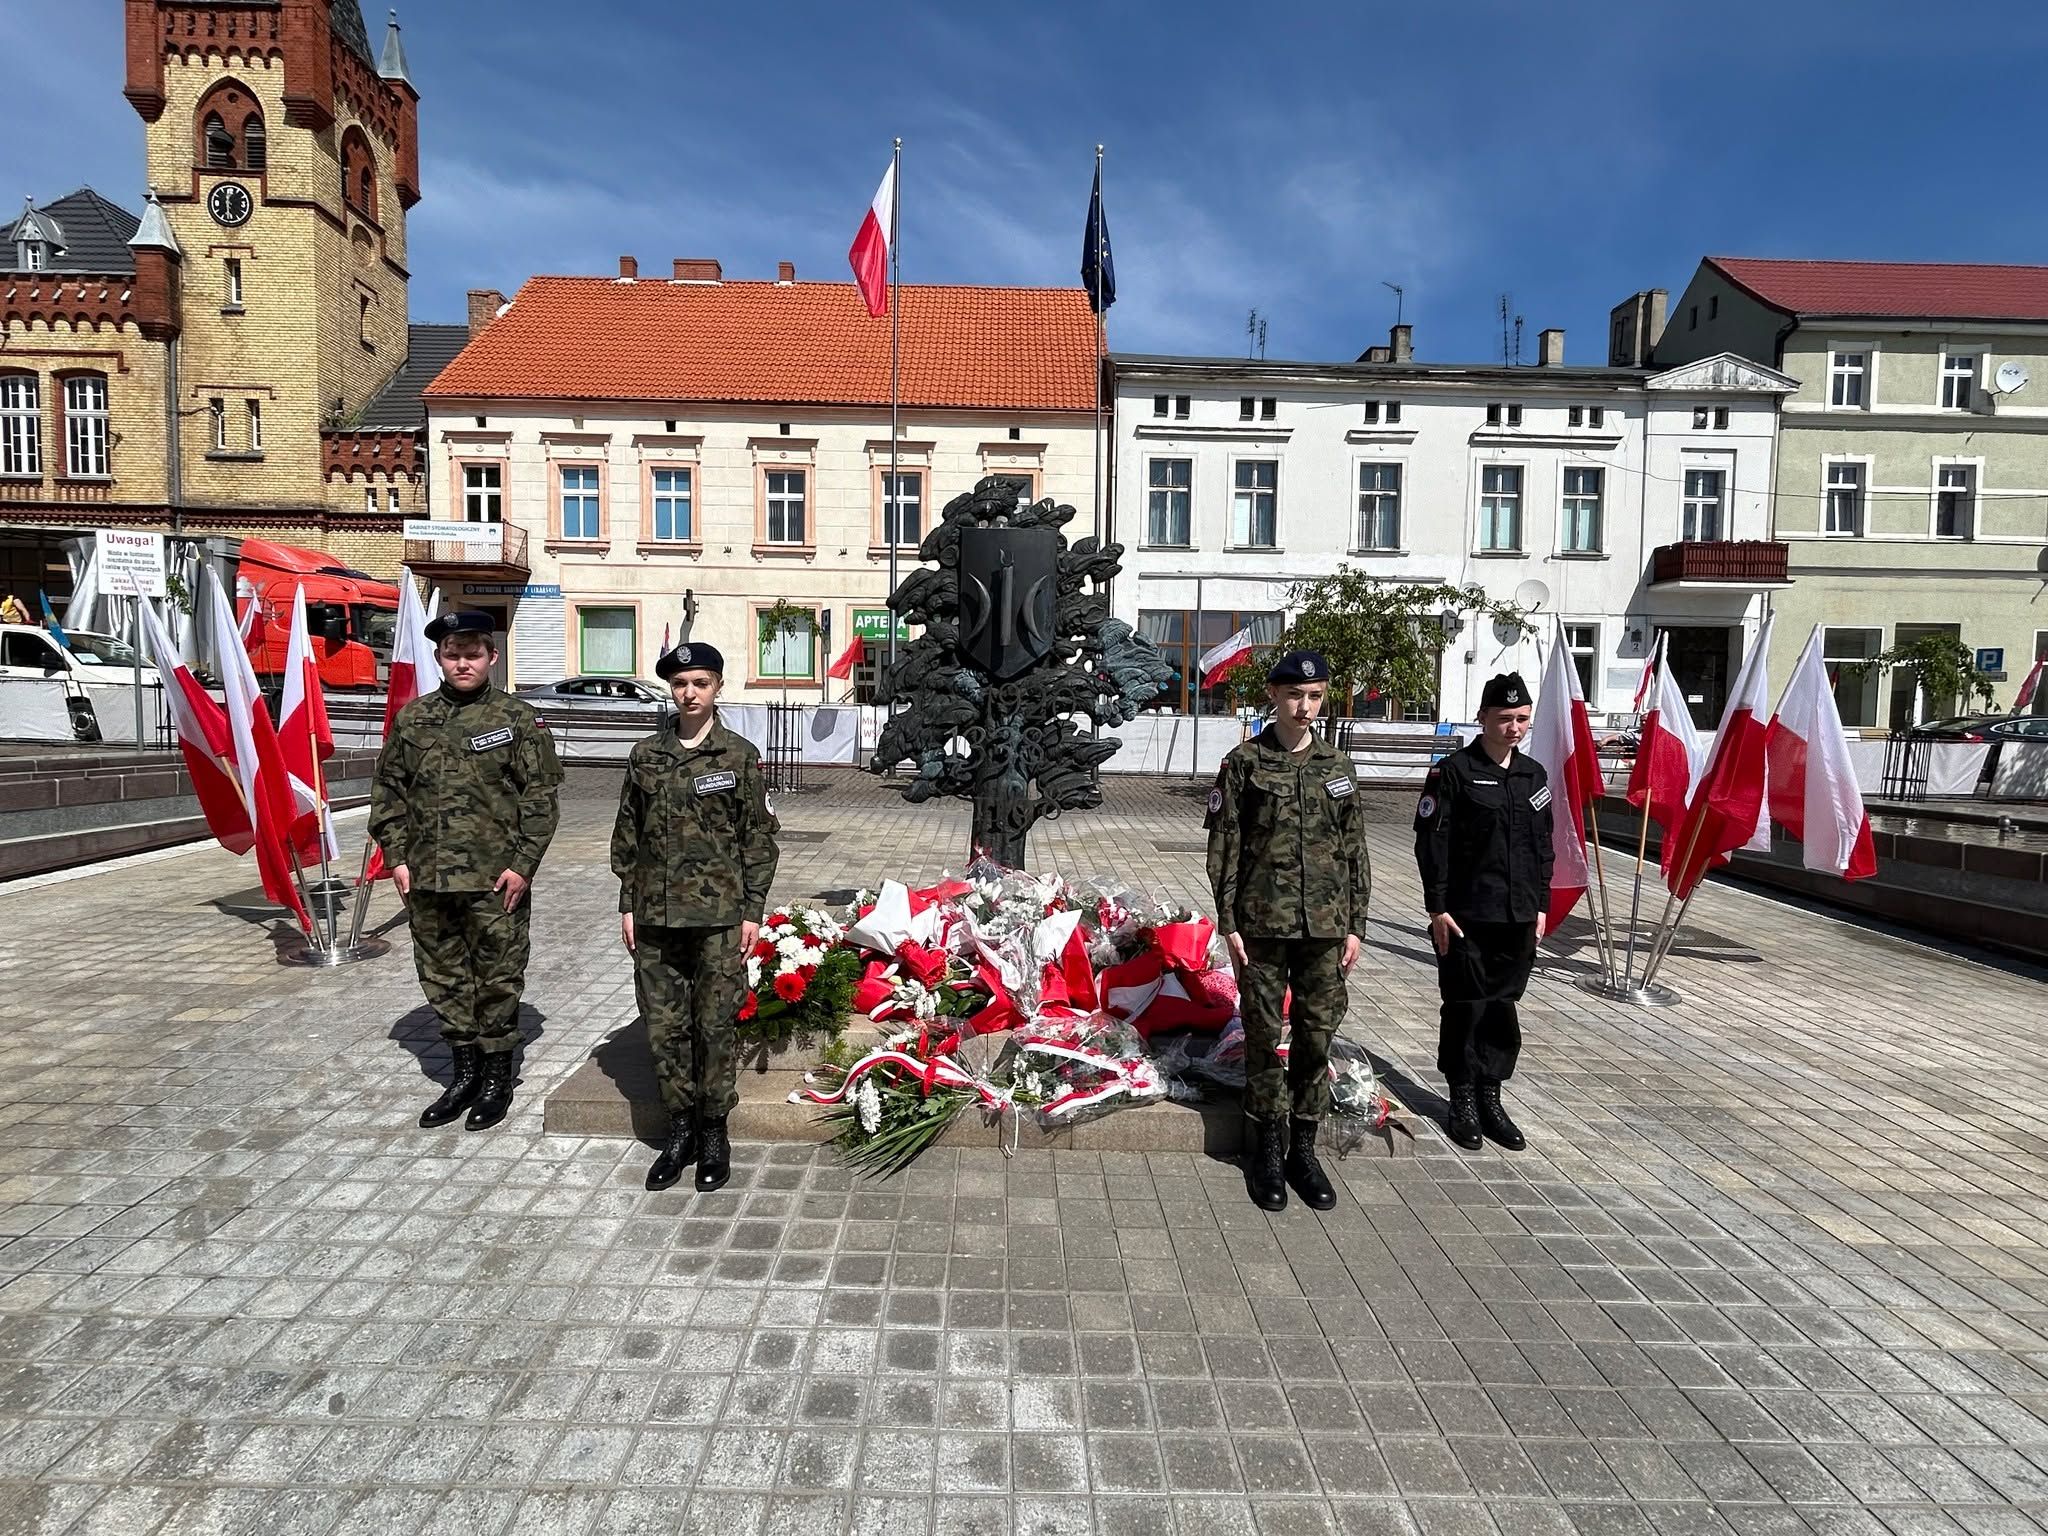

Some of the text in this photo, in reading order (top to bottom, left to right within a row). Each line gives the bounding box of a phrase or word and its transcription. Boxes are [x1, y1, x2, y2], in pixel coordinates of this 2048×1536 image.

[106, 534, 154, 547] Uwaga!
[1982, 650, 1998, 670] P
[699, 780, 733, 790] MUNDUROWA
